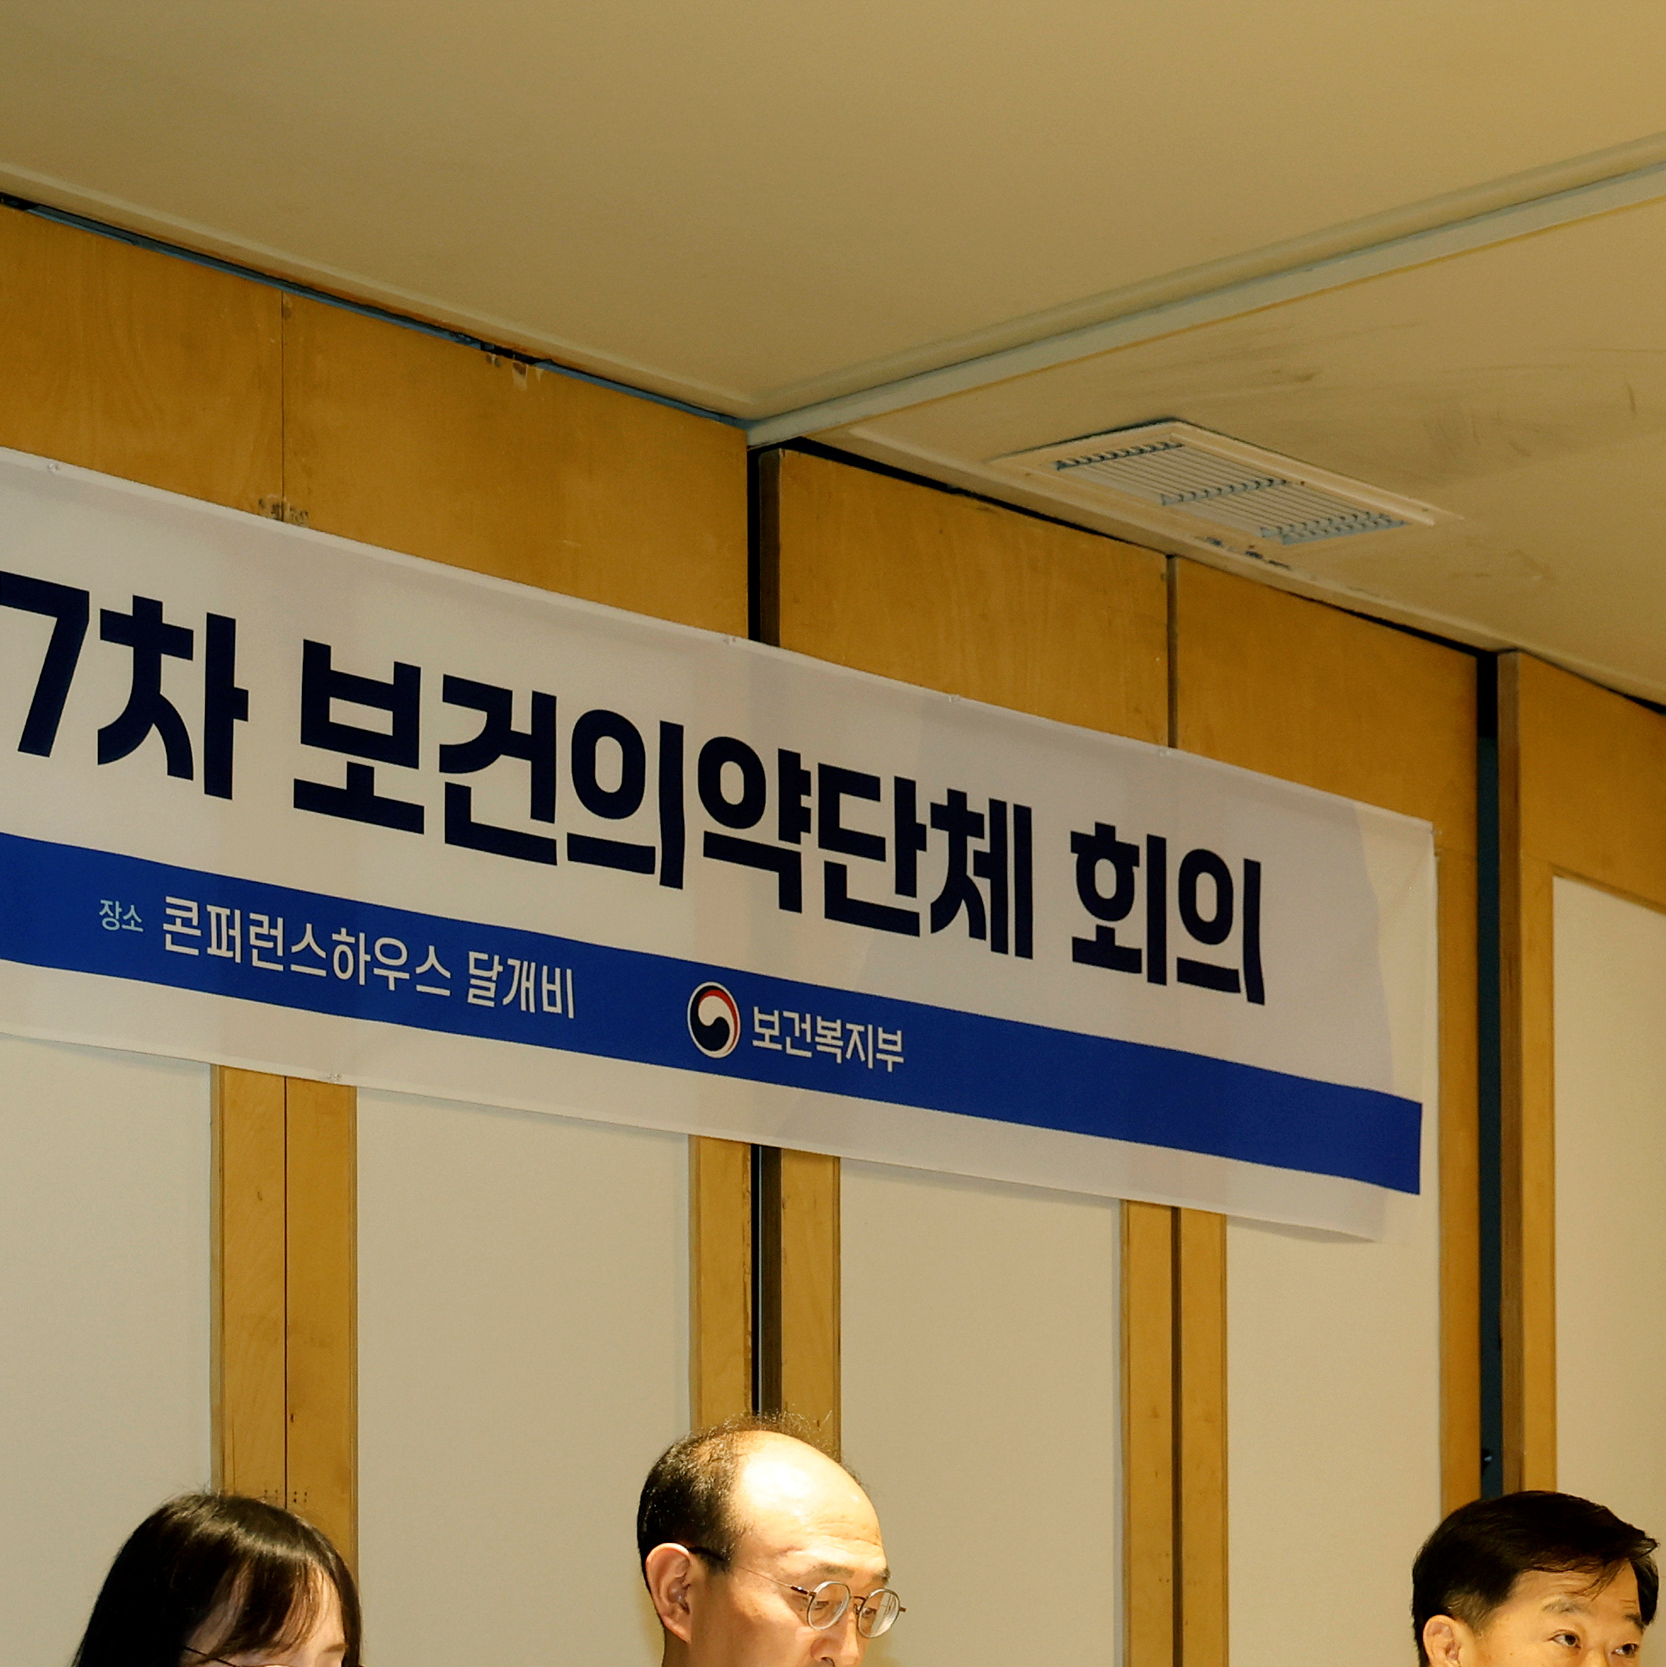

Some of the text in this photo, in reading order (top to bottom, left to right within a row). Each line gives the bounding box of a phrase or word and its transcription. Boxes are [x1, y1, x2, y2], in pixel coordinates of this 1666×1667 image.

[293, 638, 1034, 960] 보건의약단체
[1070, 821, 1265, 1006] 회의
[99, 895, 574, 1019] 장소 콘퍼런스하우스 달개비
[752, 1006, 905, 1073] 보건복지부
